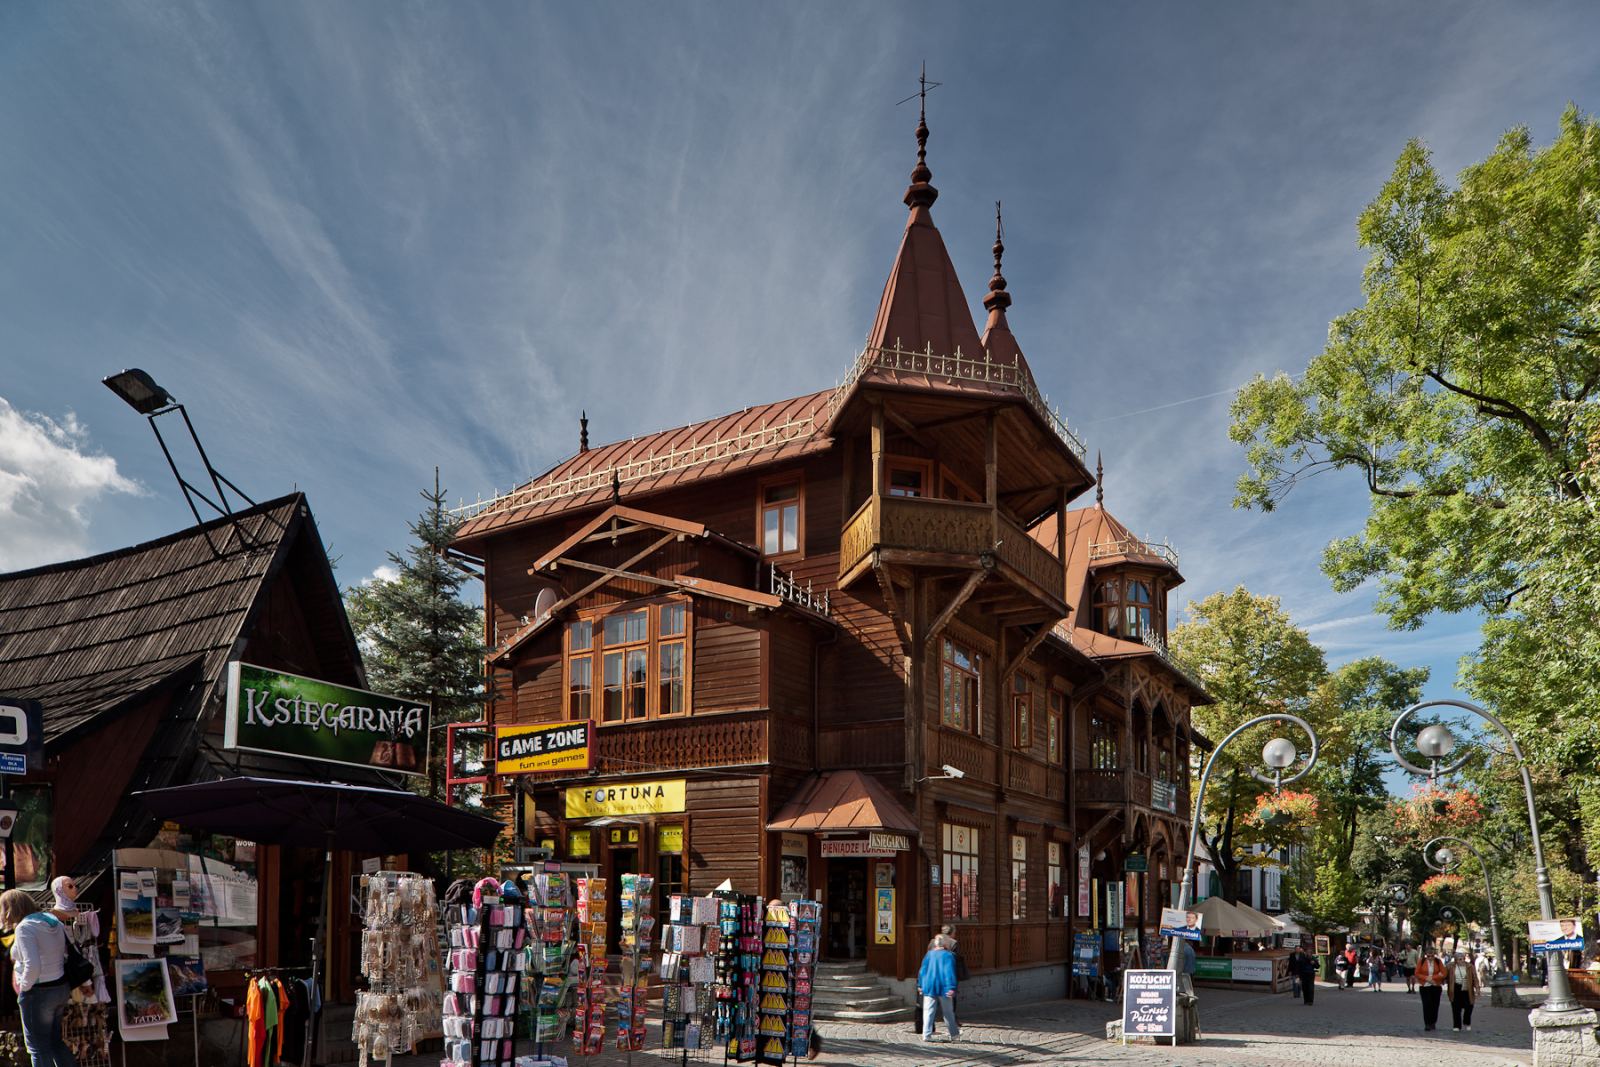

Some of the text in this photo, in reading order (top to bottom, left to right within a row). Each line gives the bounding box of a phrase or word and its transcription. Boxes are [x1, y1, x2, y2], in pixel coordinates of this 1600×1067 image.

[244, 688, 424, 738] KSIĘGARNIA
[501, 728, 586, 757] GAME ZONE
[519, 762, 535, 770] fun
[551, 754, 585, 766] games
[584, 785, 665, 803] FORTUNA
[1129, 973, 1171, 984] KOŻUCHY
[134, 1014, 163, 1024] TATRY
